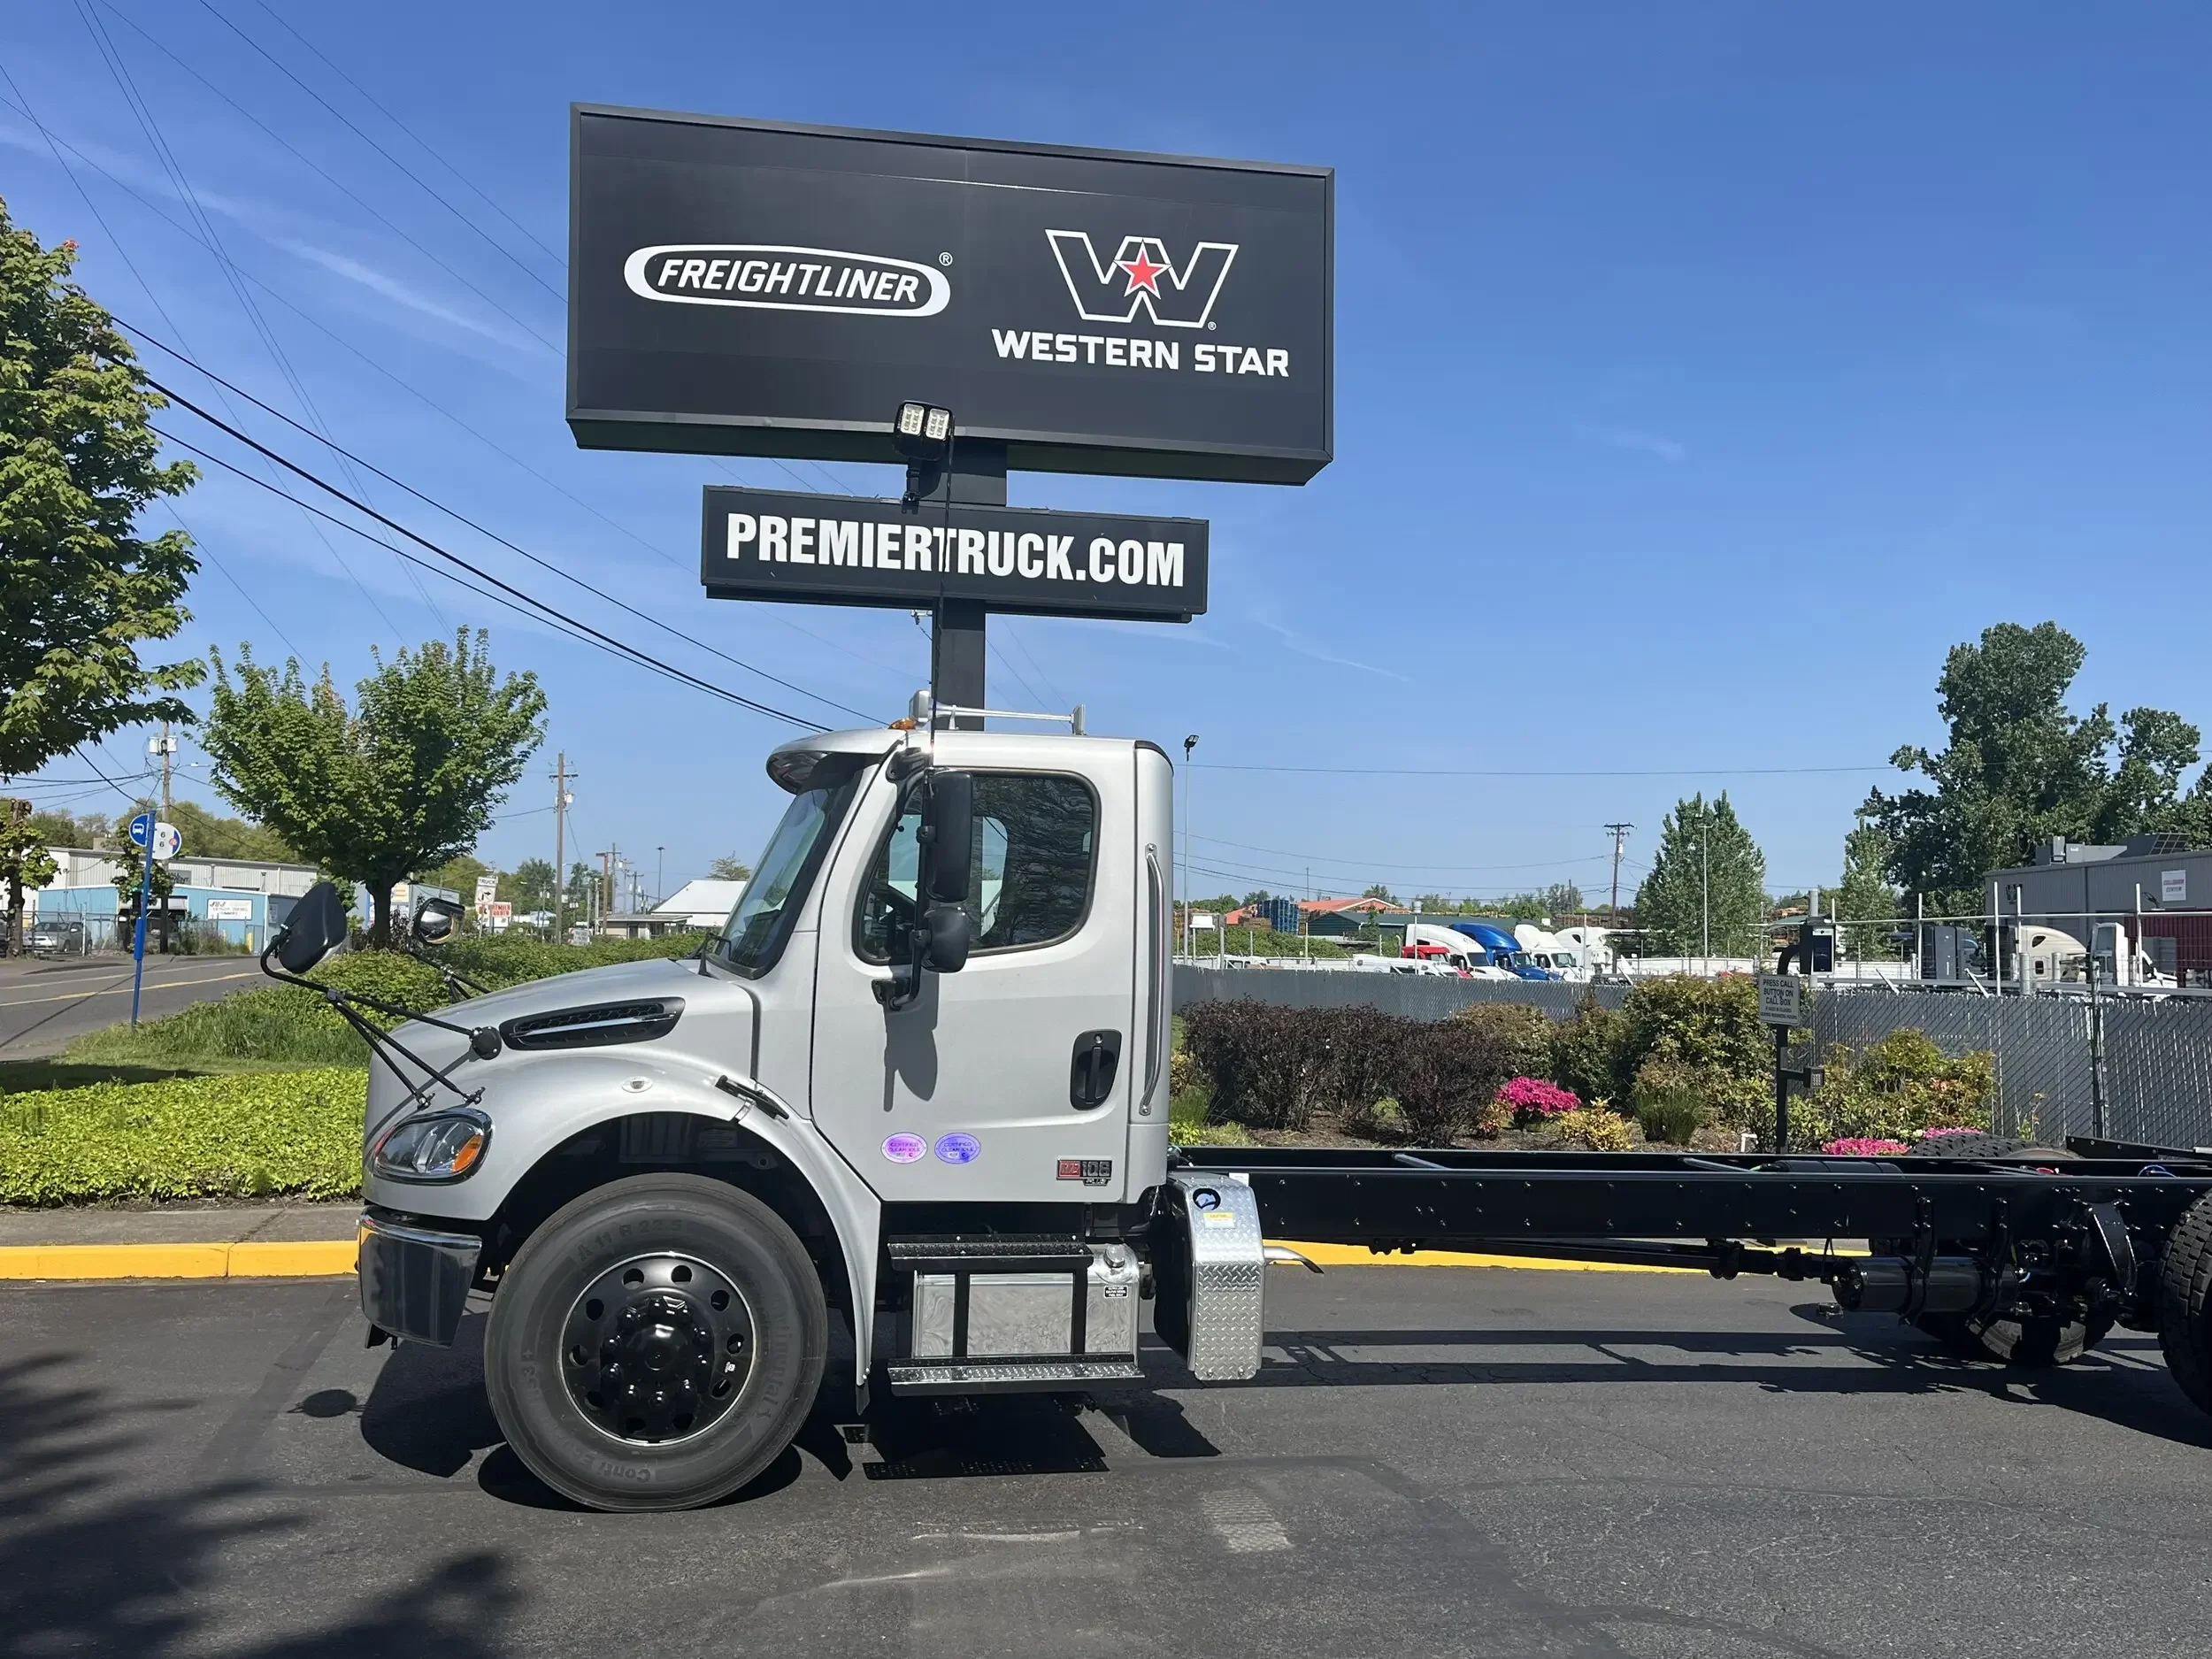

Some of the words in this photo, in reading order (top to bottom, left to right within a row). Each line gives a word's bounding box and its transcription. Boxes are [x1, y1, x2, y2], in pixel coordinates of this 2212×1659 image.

[657, 258, 919, 303] FREIGHTLINER
[991, 328, 1179, 370] WESTERN
[1194, 344, 1288, 377] STAR
[726, 512, 1184, 587] PREMIERTRUCK.COM
[1763, 987, 1785, 996] BUTTON
[1082, 1161, 1110, 1177] 106
